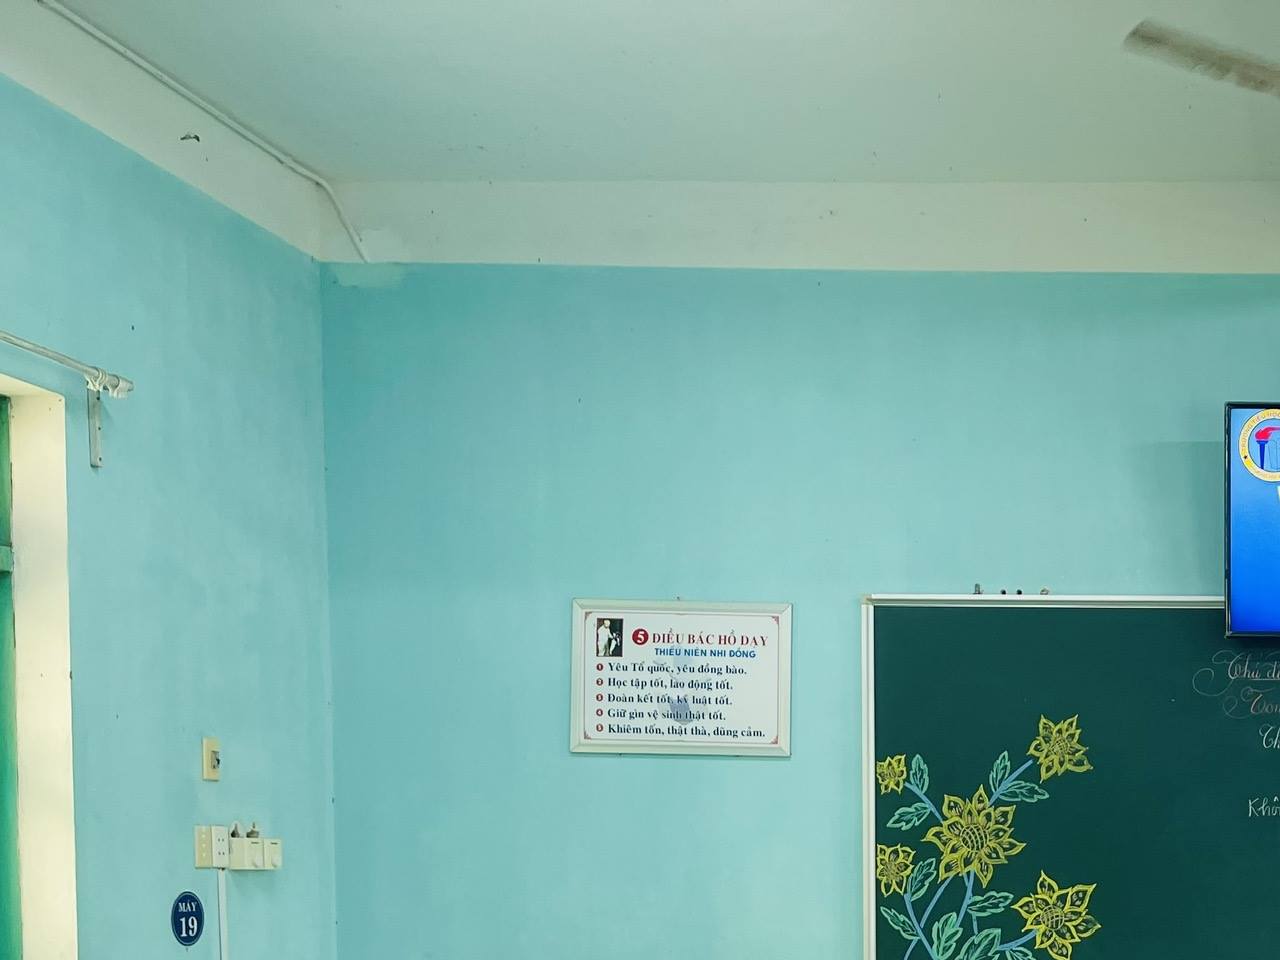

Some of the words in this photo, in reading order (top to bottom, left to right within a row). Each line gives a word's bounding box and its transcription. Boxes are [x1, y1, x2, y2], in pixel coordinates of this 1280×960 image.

[653, 628, 684, 644] ĐIỀU
[688, 631, 715, 645] BÁC
[718, 629, 737, 646] HỒ
[741, 635, 768, 648] DẠY
[655, 646, 681, 656] THIẾU
[684, 646, 707, 657] NIÊN
[710, 649, 726, 657] NHI
[729, 648, 756, 658] ĐỒNG
[608, 662, 628, 671] Yêu
[631, 660, 645, 671] Tổ
[647, 662, 674, 674] quốc,
[677, 665, 695, 675] yêu
[698, 663, 723, 675] đồng
[725, 665, 747, 675] bào.
[608, 678, 627, 689] Học
[631, 678, 647, 690] tập
[650, 677, 667, 689] tốt,
[670, 679, 685, 688] lao
[688, 680, 713, 691] động
[715, 679, 733, 690] tốt.
[608, 693, 634, 703] Đoàn
[637, 692, 653, 703] kết
[692, 695, 711, 706] luật
[715, 695, 733, 705] tốt.
[608, 708, 627, 718] Giữ
[629, 709, 644, 720] gìn
[647, 709, 659, 721] vệ
[661, 710, 682, 719] sinh
[685, 710, 705, 721] thật
[708, 710, 726, 720] tốt.
[608, 723, 641, 734] Khiêm
[644, 723, 665, 735] tốn,
[667, 725, 688, 736] thật
[691, 725, 710, 736] thà,
[713, 726, 738, 738] dũng
[740, 726, 766, 737] cảm.
[178, 899, 198, 913] MÁY
[180, 916, 198, 938] 19
